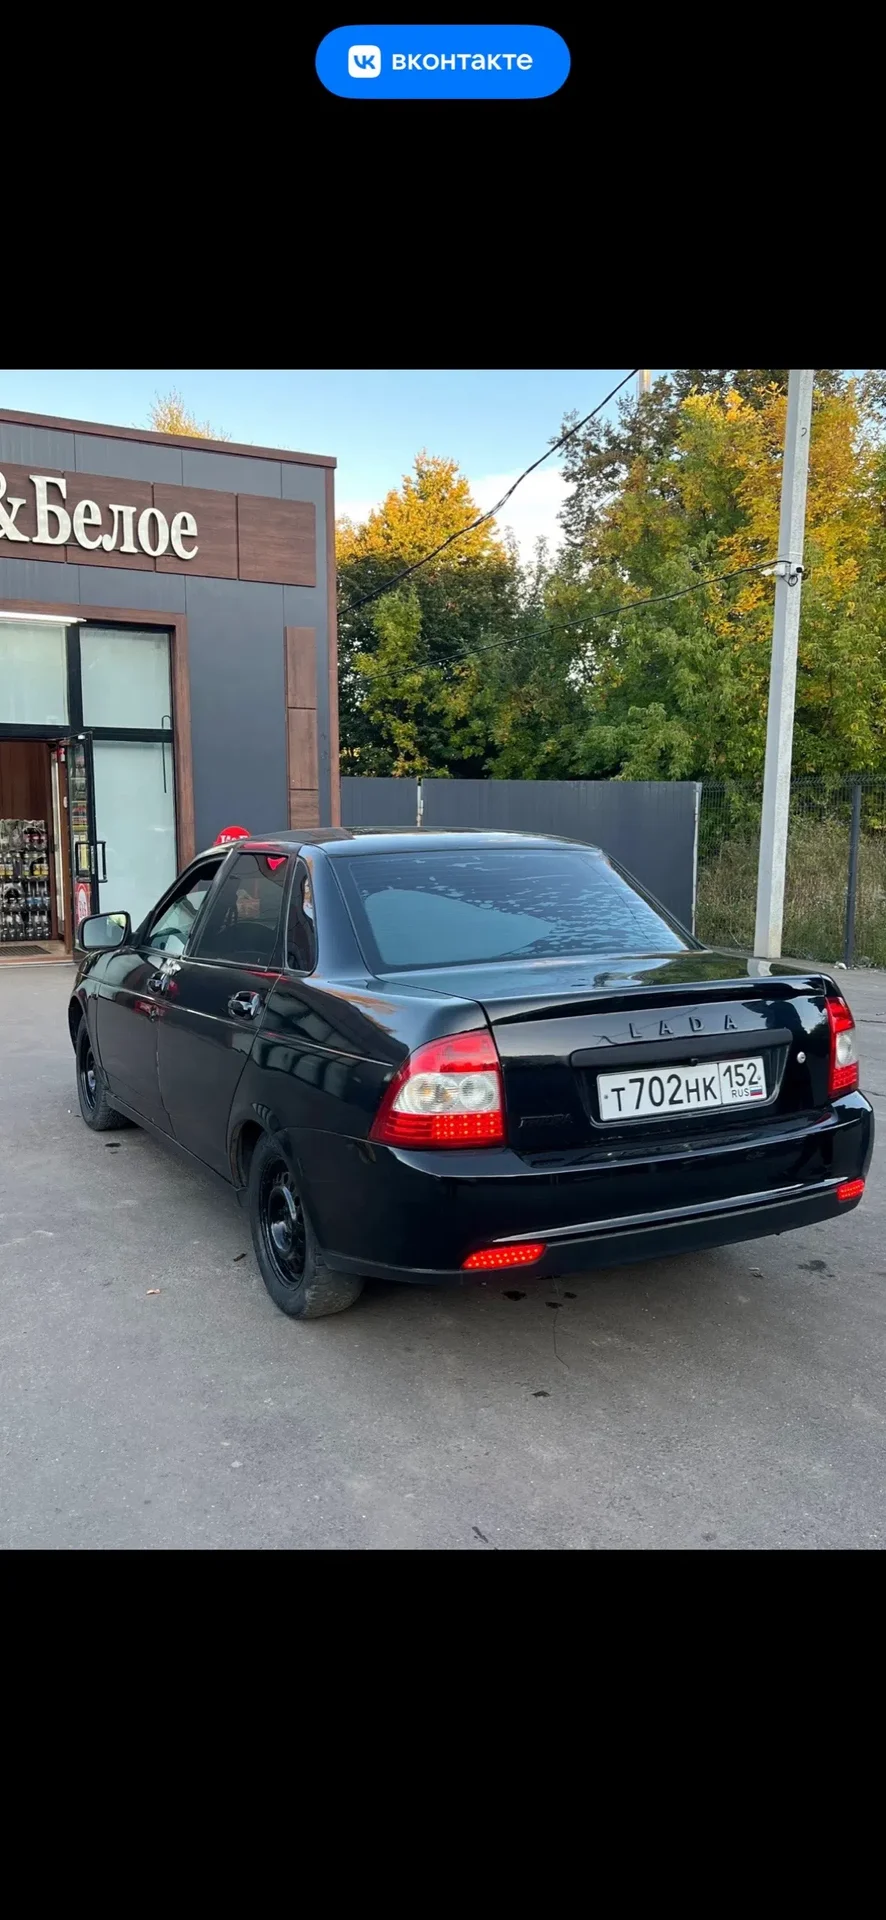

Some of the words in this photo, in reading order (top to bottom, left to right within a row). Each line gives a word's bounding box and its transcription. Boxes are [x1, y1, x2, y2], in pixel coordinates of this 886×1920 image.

[628, 1014, 738, 1038] LADA
[611, 1074, 718, 1112] Т702НК
[723, 1062, 759, 1088] 152
[731, 1088, 750, 1098] RUS
